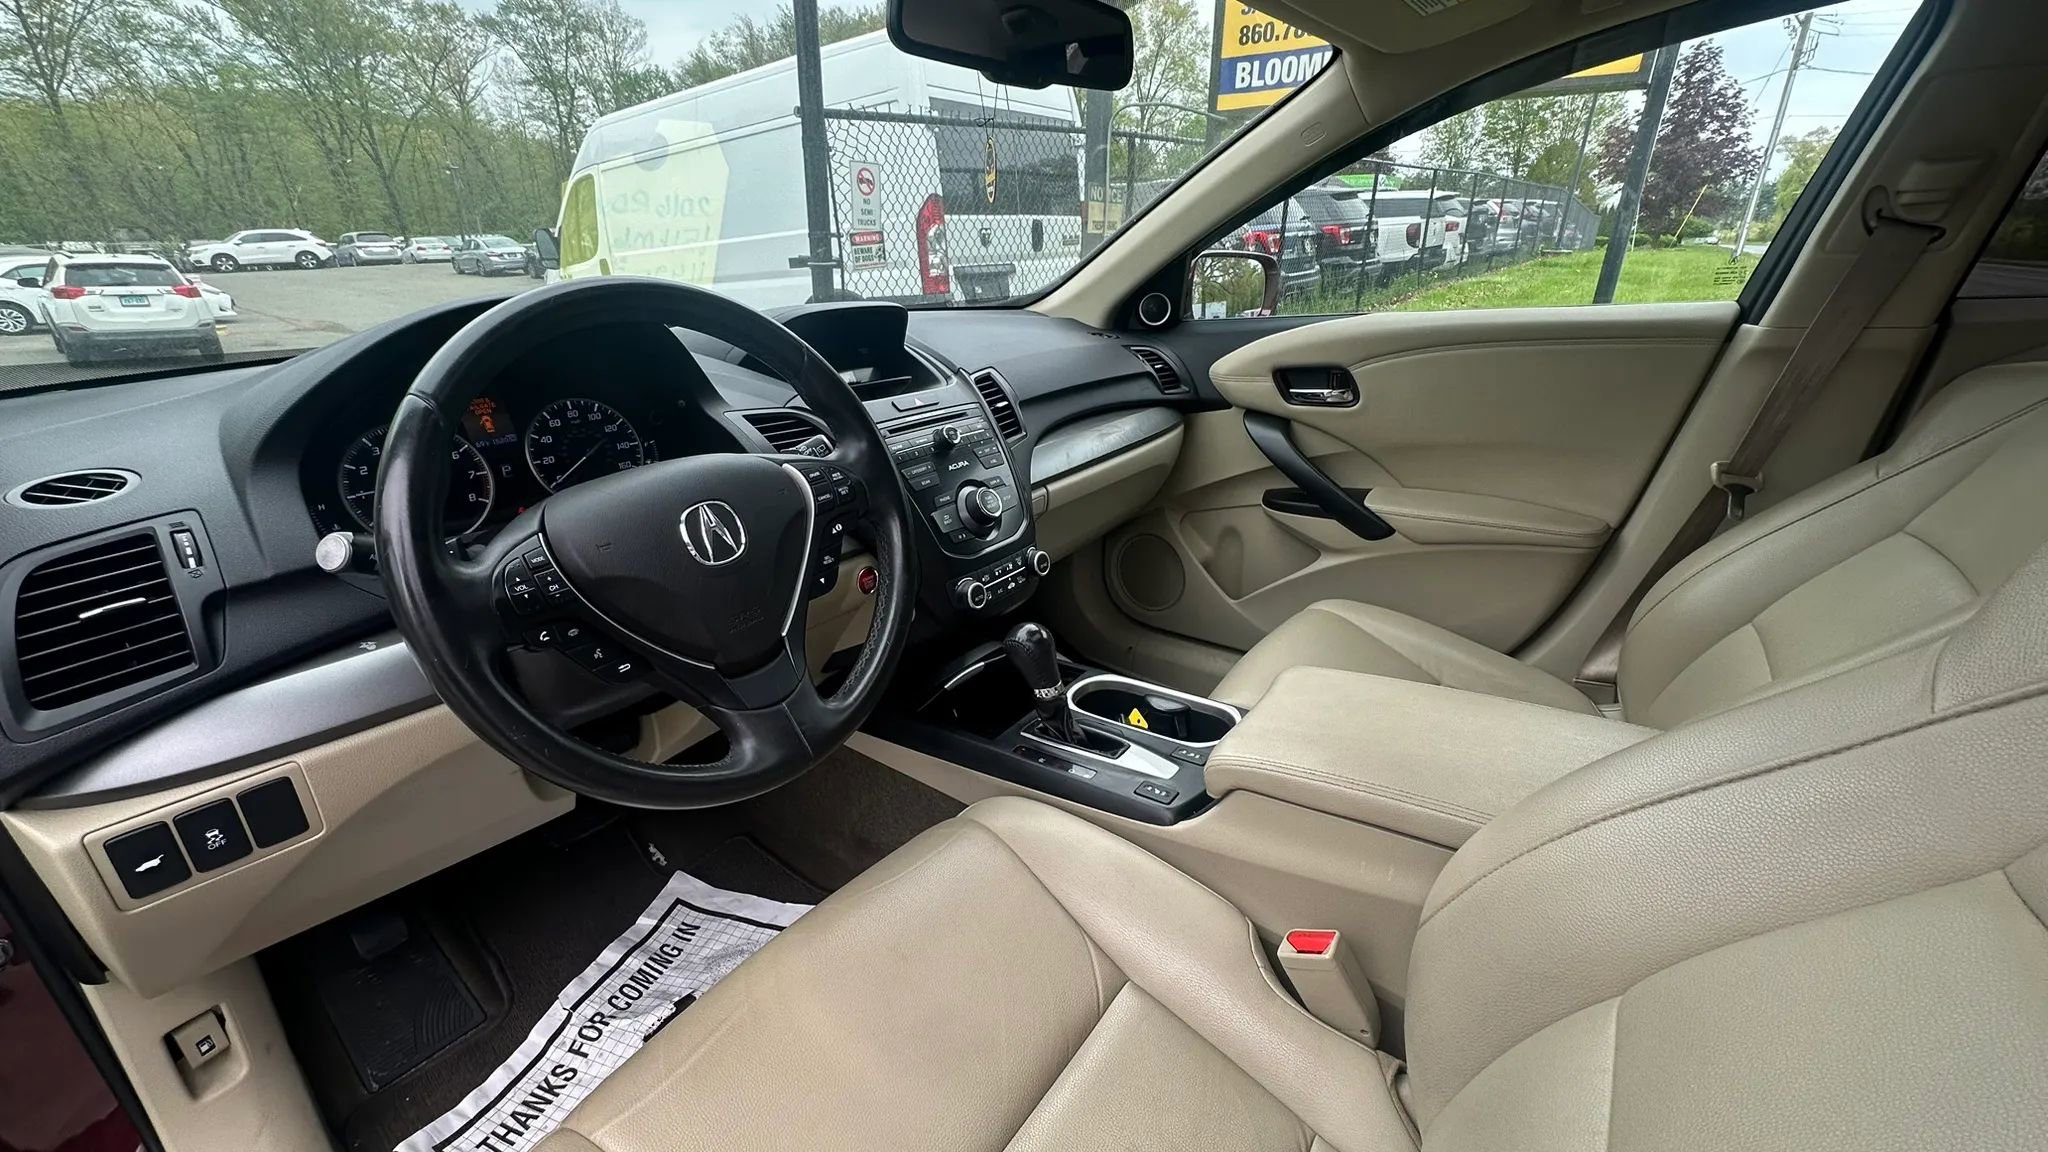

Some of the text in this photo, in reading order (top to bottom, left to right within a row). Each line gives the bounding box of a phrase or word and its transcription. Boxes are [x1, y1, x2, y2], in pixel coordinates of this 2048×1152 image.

[1238, 20, 1312, 46] 860.7
[863, 197, 871, 206] NO
[860, 208, 874, 217] SEMI
[858, 218, 877, 227] TRUCKS
[853, 246, 873, 256] BEWARE
[567, 409, 579, 418] 80
[587, 412, 602, 421] 100
[548, 418, 561, 428] 60
[604, 424, 618, 433] 120
[540, 435, 553, 444] 40
[616, 441, 630, 450] 140
[371, 446, 381, 456] 3
[451, 451, 461, 460] 6
[542, 455, 555, 465] 20
[618, 460, 632, 469] 160
[948, 459, 970, 471] ACURA
[359, 465, 369, 475] 2
[501, 465, 512, 479] P
[467, 470, 475, 480] 7
[468, 493, 477, 502] 8
[514, 583, 530, 592] VOL
[548, 583, 560, 592] CH
[207, 838, 227, 850] OFF
[474, 920, 702, 1152] THANKS FOR COMING IN
